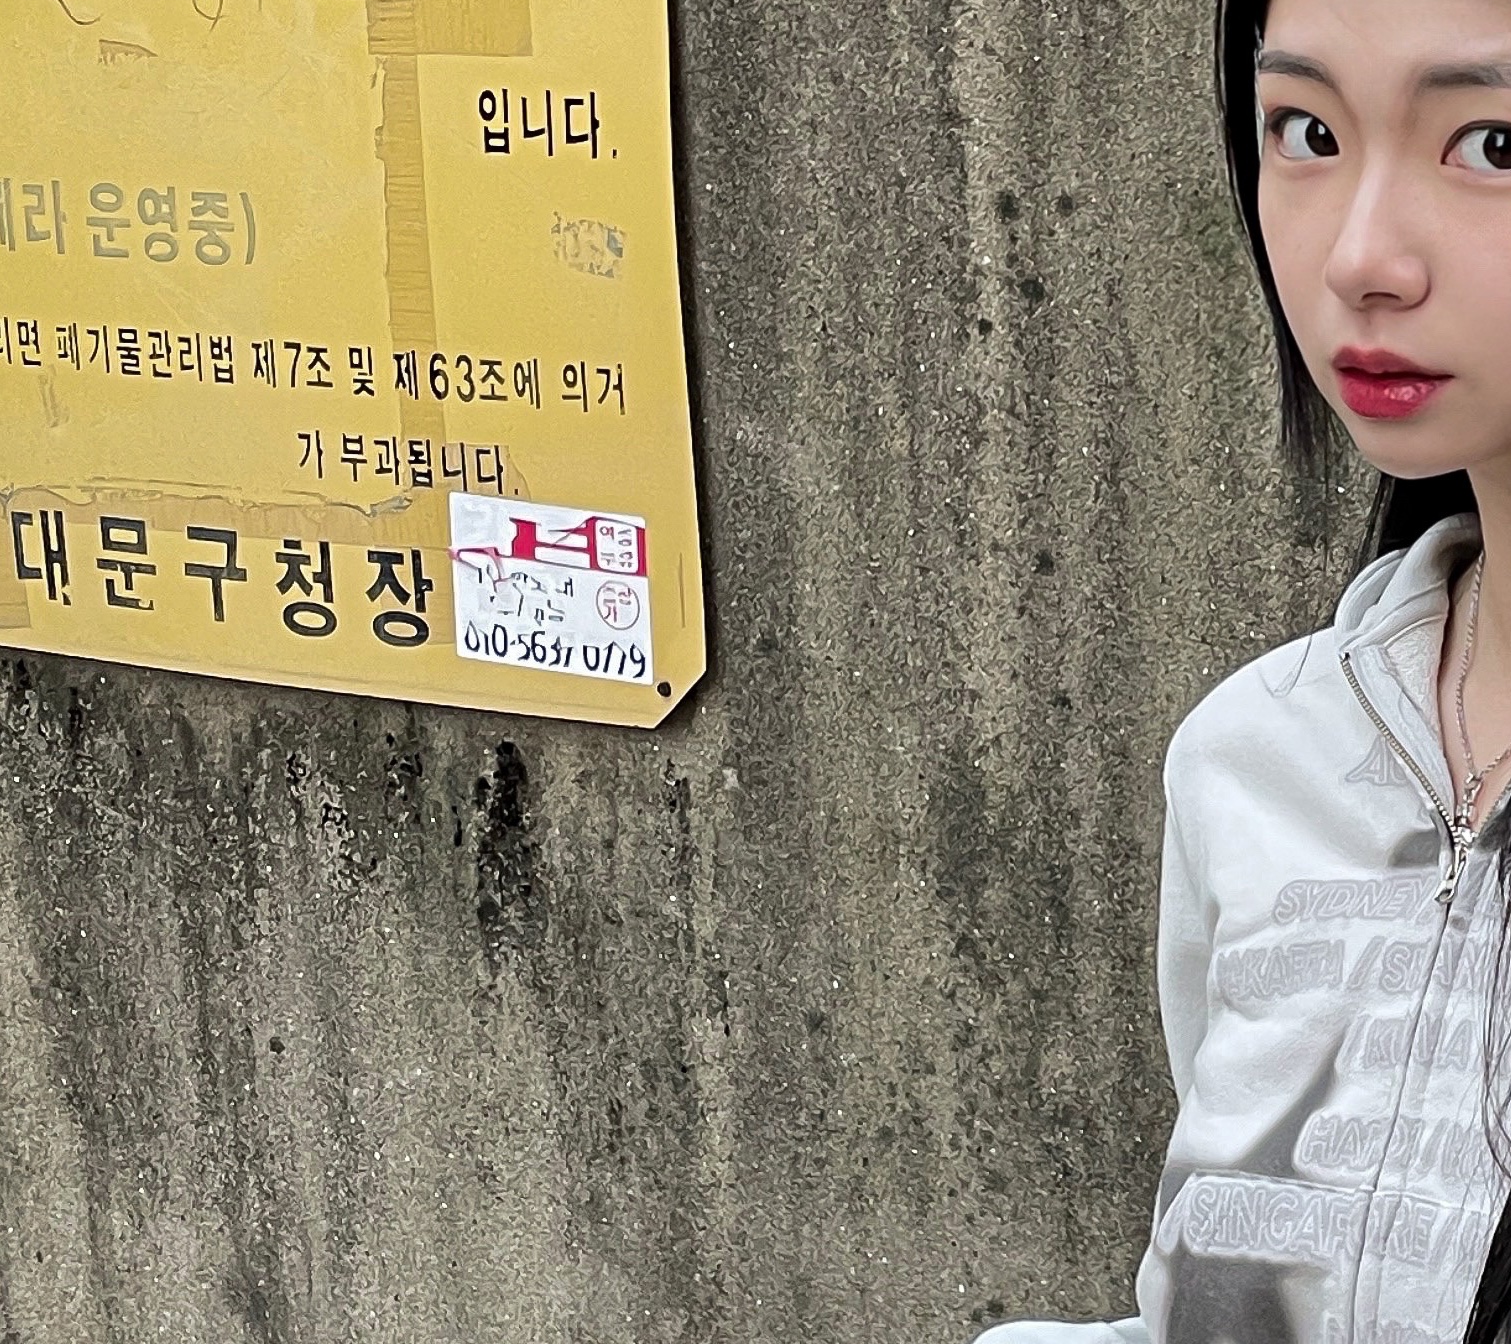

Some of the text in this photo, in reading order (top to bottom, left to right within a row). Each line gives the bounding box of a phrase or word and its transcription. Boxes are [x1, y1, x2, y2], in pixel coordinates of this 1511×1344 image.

[479, 88, 618, 159] 입니다.
[86, 182, 256, 265] 운영중)
[251, 338, 334, 389] 제7조
[348, 346, 375, 397] 및
[393, 350, 541, 410] 제63조에
[562, 360, 627, 415] 의거
[341, 432, 520, 496] 부과됩니다.
[1273, 867, 1438, 928] SYDNEY
